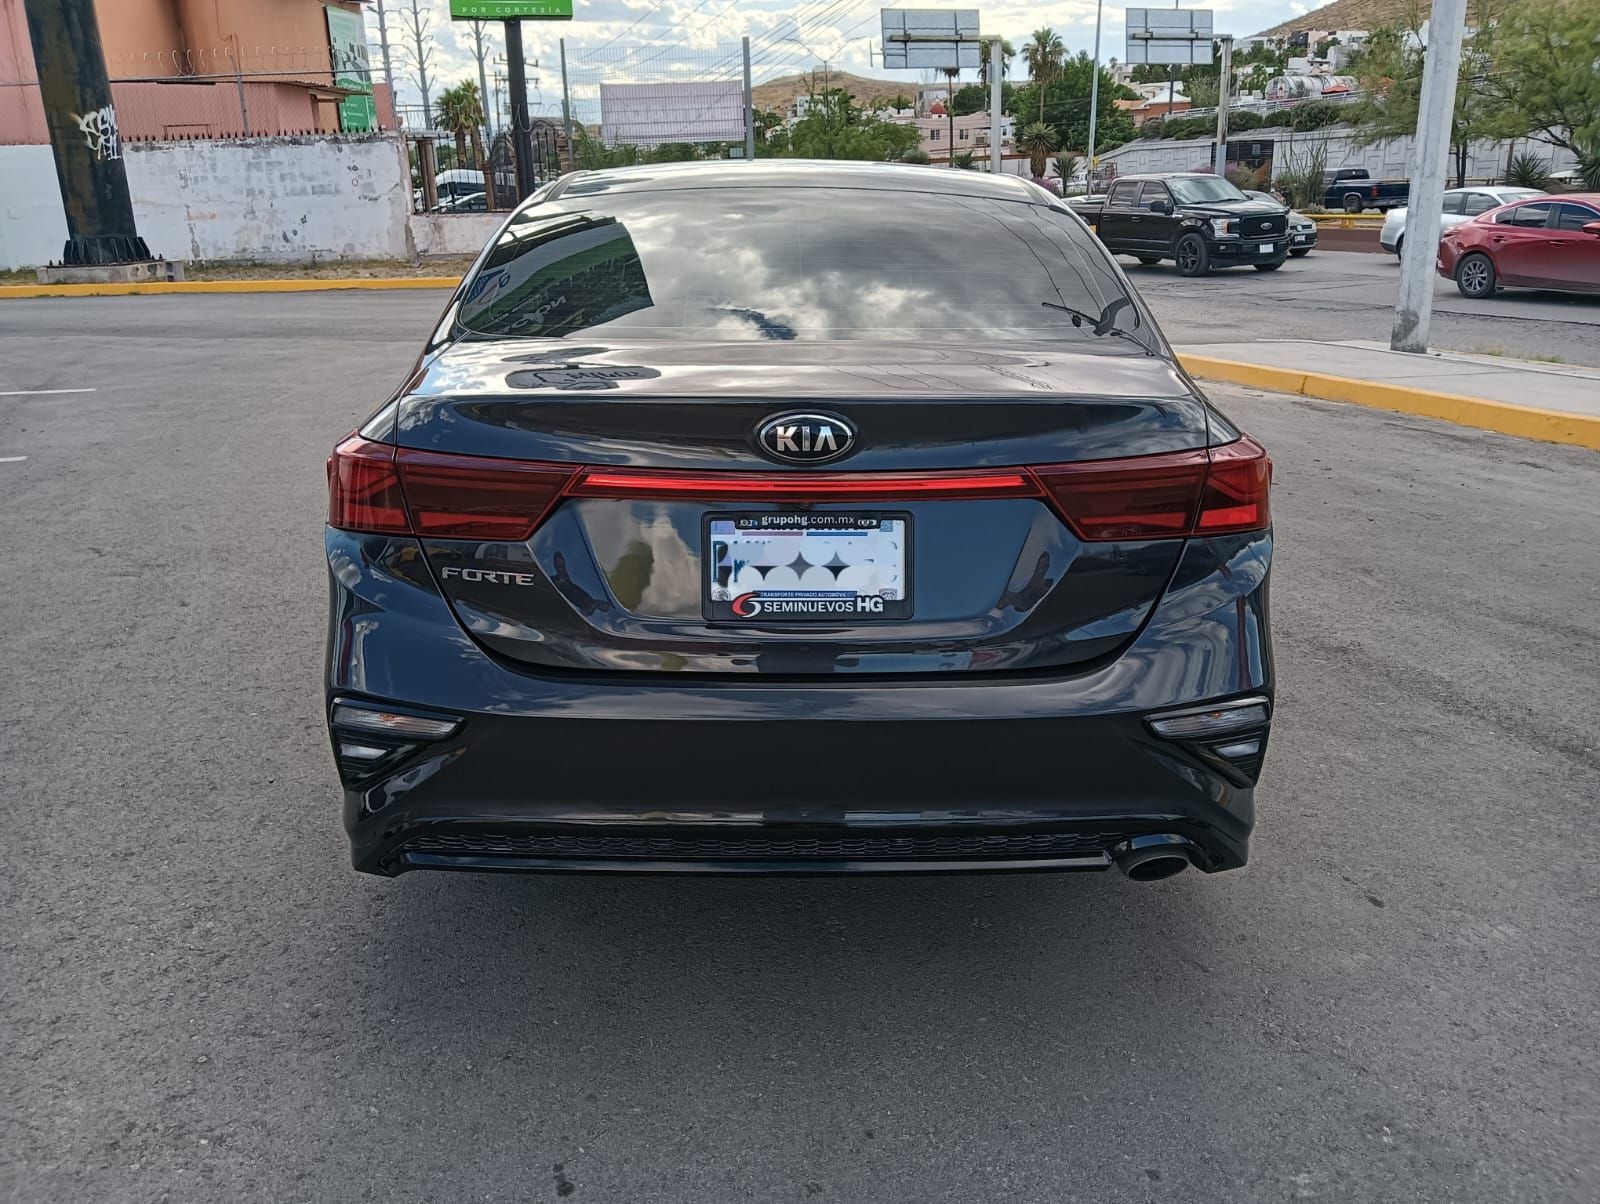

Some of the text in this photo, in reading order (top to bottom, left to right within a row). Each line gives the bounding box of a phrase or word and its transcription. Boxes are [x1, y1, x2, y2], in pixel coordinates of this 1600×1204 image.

[776, 426, 838, 451] KIA
[761, 514, 855, 526] grupohg.com.mx
[442, 566, 534, 585] FORTE
[764, 597, 884, 612] SEMINUEVOS HG
